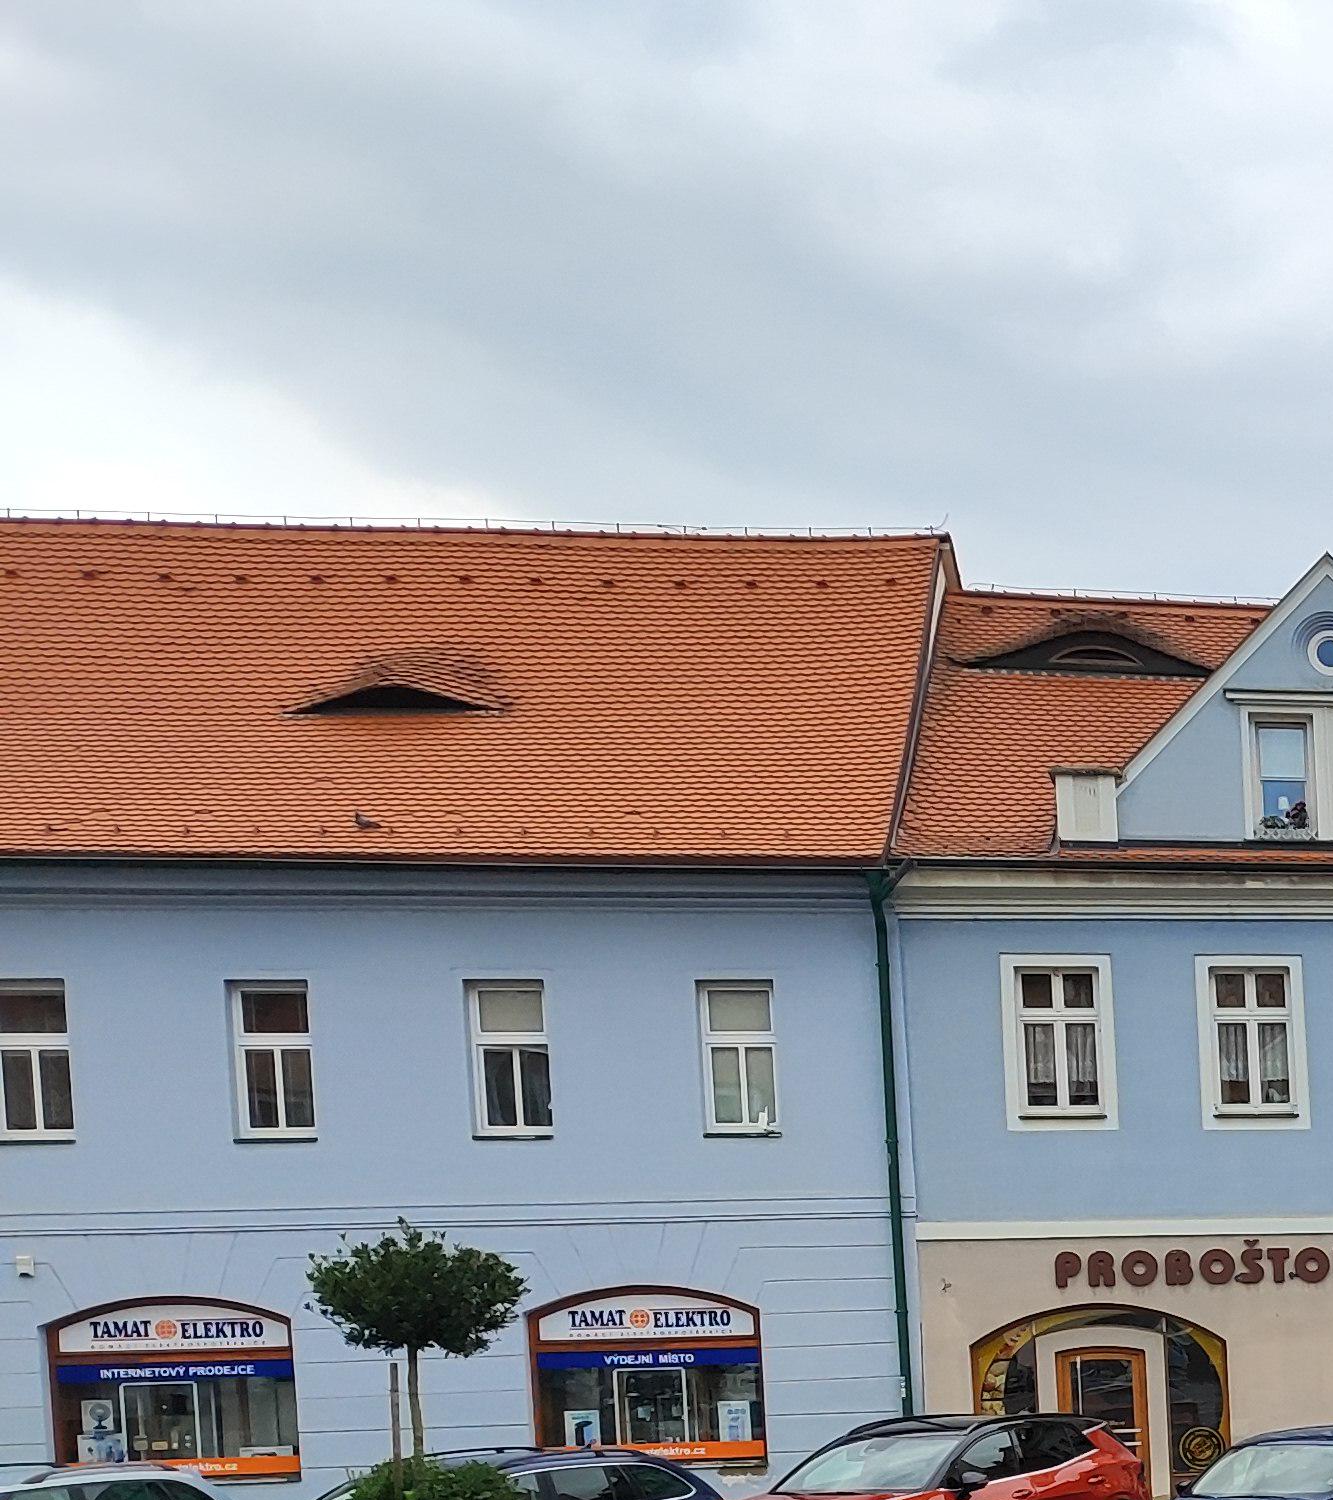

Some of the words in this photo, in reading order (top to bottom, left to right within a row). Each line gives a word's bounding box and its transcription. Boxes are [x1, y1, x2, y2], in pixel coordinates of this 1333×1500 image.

[568, 1309, 626, 1328] TAMAT
[653, 1309, 731, 1328] ELEKTRO
[90, 1320, 151, 1339] TAMAT
[180, 1320, 264, 1340] ELEKTRO
[603, 1352, 653, 1365] VÝDEJNÍ
[658, 1351, 695, 1364] MÍSTO
[100, 1365, 185, 1380] INTERNETOVÝ
[189, 1364, 256, 1377] PRODEJCE
